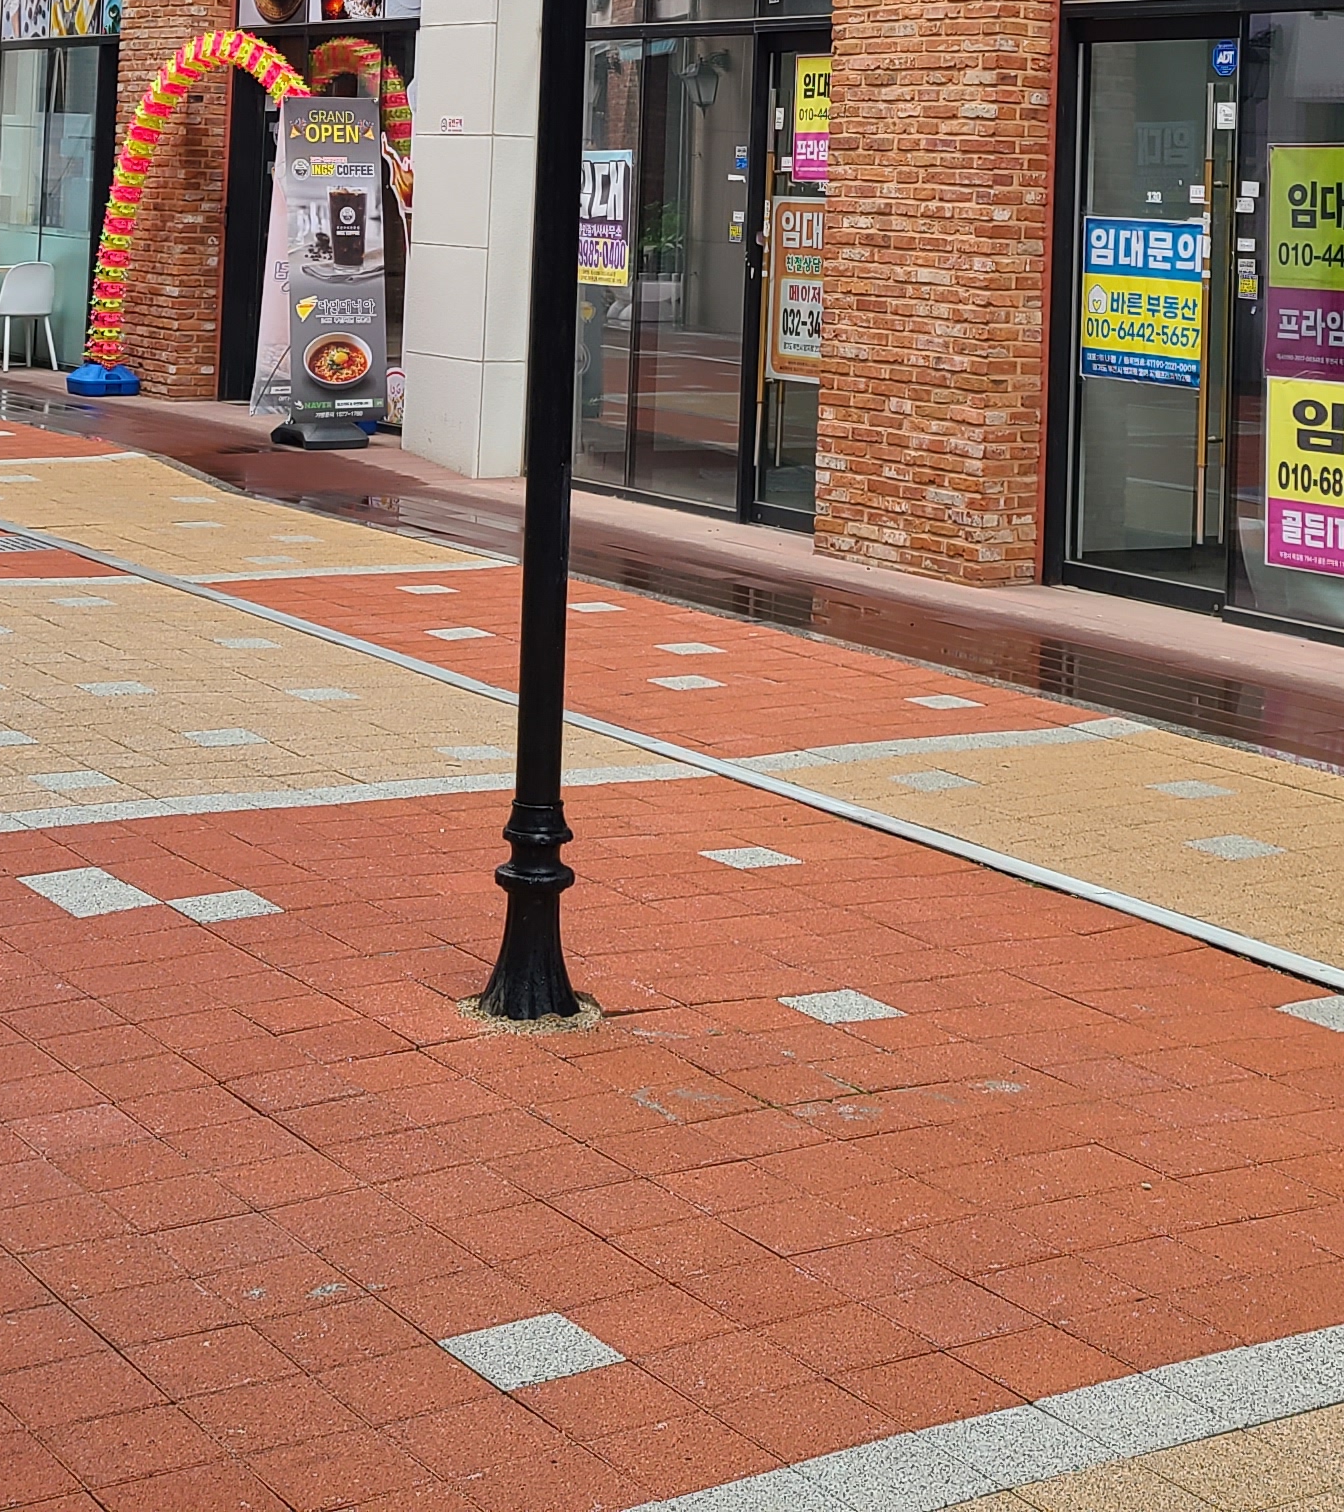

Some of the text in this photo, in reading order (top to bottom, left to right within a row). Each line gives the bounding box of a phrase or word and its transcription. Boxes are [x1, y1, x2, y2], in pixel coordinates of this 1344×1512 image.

[1216, 50, 1234, 65] ADT
[803, 72, 831, 99] 임대
[308, 109, 355, 124] GRAND
[305, 124, 360, 144] OPEN
[796, 139, 829, 162] 프라임
[336, 164, 375, 177] COFFEE
[579, 223, 623, 239] 인중개사사무소
[782, 210, 824, 250] 임대
[1089, 228, 1204, 273] 임대문의
[786, 254, 822, 274] 친절상담
[788, 284, 821, 305] 메이저
[1109, 289, 1198, 323] 바른 부동산
[1085, 318, 1201, 350] 010-6442-5657
[304, 401, 333, 410] NAVER
